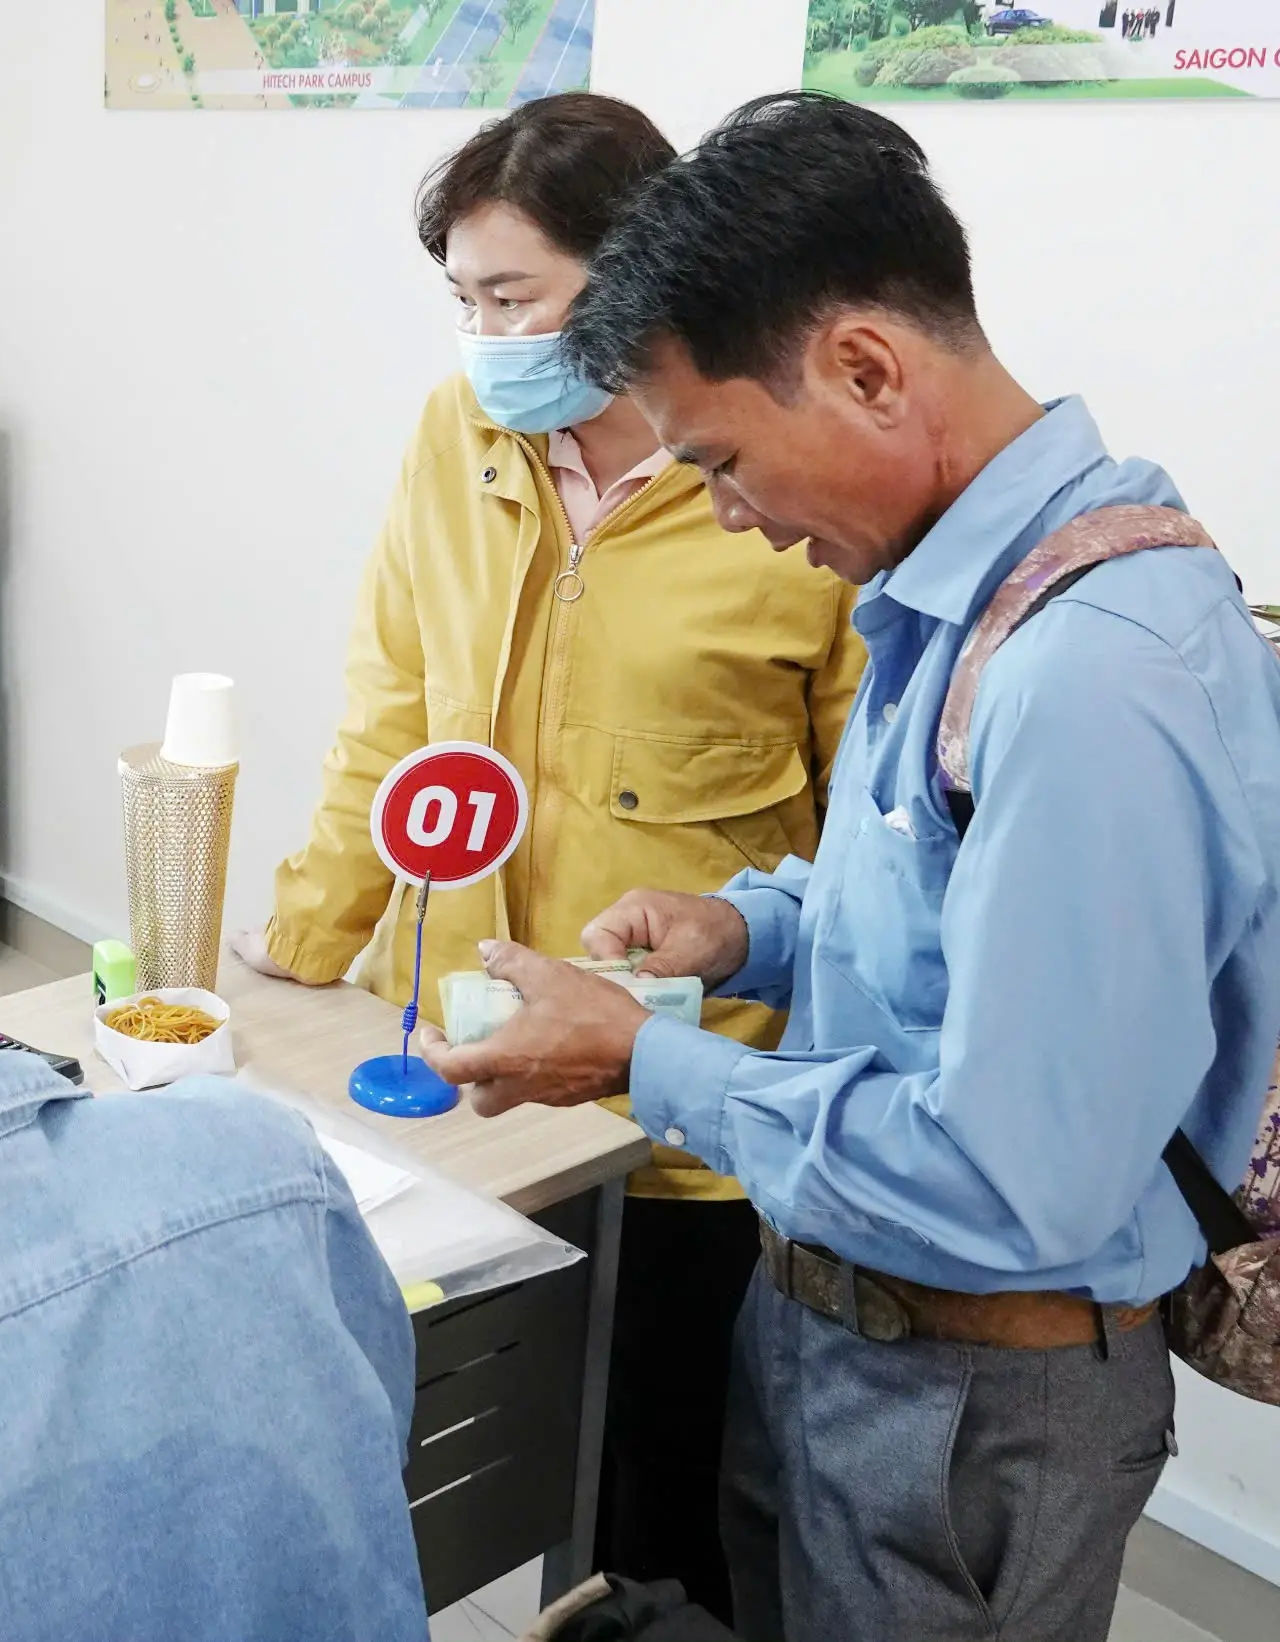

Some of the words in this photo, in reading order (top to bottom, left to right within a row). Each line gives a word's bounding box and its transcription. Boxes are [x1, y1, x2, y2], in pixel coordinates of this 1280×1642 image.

[1173, 48, 1267, 70] SAIGON
[262, 74, 296, 89] HITECH
[299, 73, 324, 88] PARK
[328, 72, 372, 88] CAMPUS
[406, 784, 497, 852] 01
